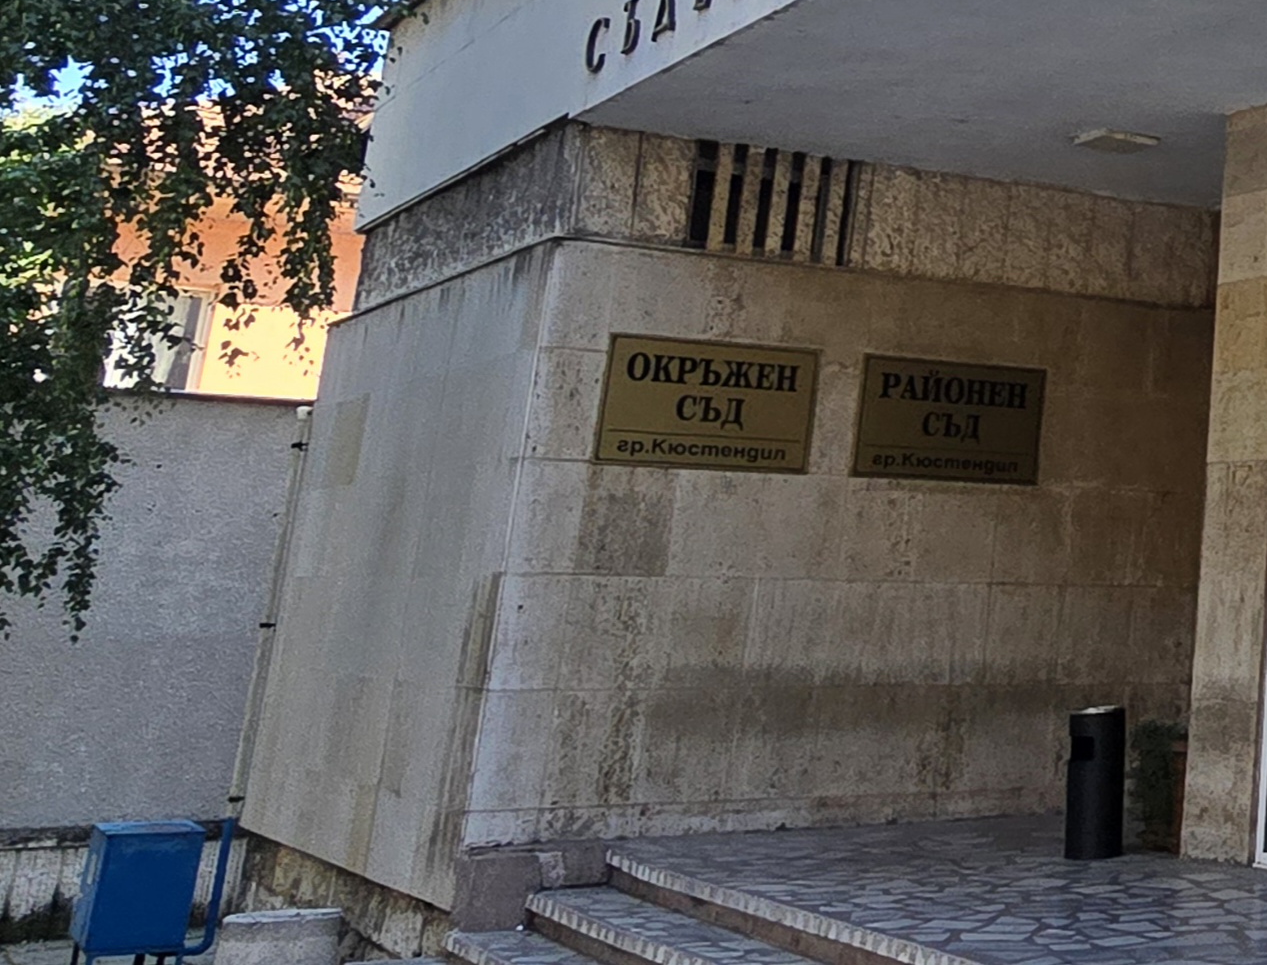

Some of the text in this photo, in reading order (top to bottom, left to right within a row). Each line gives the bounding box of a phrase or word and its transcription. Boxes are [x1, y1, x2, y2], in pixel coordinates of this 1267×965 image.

[626, 351, 800, 392] ОКРЪЖЕН
[879, 369, 1028, 409] РАЙОНЕН
[675, 394, 745, 430] СЪД
[922, 411, 981, 443] СЪД
[616, 437, 786, 462] гр.Кюстендил
